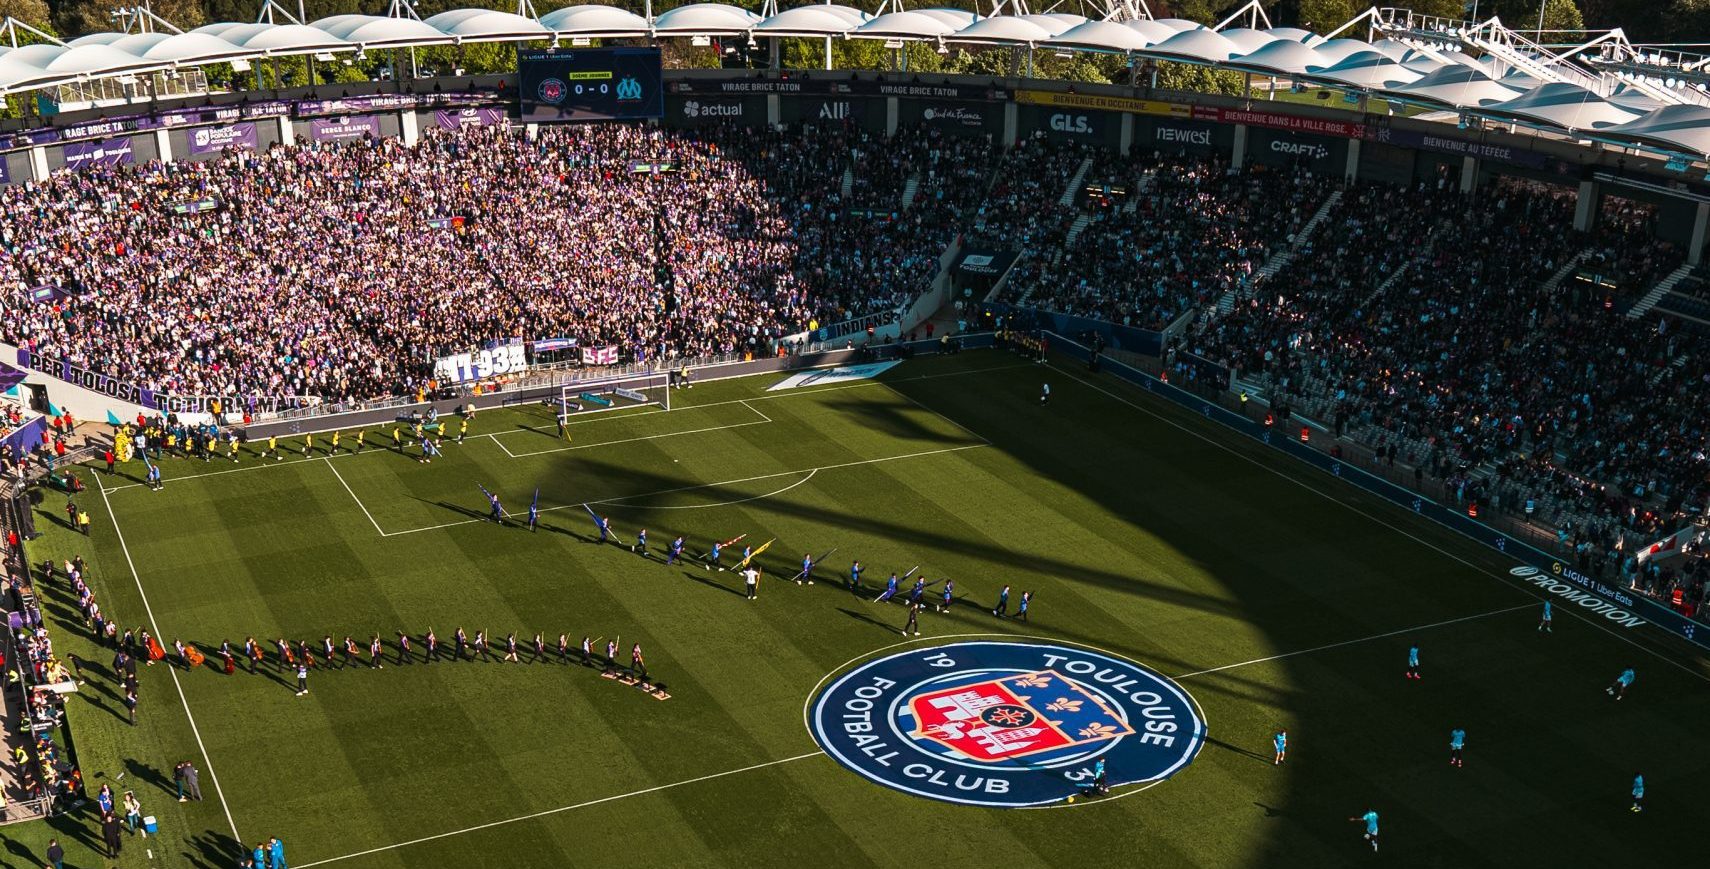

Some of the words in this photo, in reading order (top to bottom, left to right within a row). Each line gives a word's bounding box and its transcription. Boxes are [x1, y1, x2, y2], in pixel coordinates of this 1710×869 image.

[575, 84, 583, 94] 0
[600, 83, 608, 94] 0
[721, 83, 750, 91] VIRAGE
[751, 83, 774, 91] BRICE
[775, 83, 800, 92] TATON
[880, 85, 908, 94] VIRAGE
[909, 86, 932, 95] BRICE
[933, 87, 958, 97] TATON
[701, 103, 742, 116] actual
[1053, 94, 1095, 106] BIENVENUE
[1107, 99, 1147, 110] OCCITANIE
[87, 122, 112, 138] BRICE
[112, 119, 138, 135] TATON
[344, 124, 371, 132] BLANCO
[1050, 113, 1093, 134] GLS.
[1224, 112, 1267, 124] BIENVENUE
[1268, 116, 1289, 126] DANS
[1290, 118, 1300, 128] LA
[1302, 119, 1324, 130] VILLE
[1270, 140, 1316, 156] CRAFT
[1423, 136, 1467, 152] BIENVENUE
[1467, 143, 1479, 154] AU
[29, 352, 64, 379] PER
[70, 366, 143, 405] TOLOSA
[1563, 567, 1590, 585] LIGUE
[1590, 579, 1596, 589] 1
[1596, 583, 1615, 598] Uber
[1615, 591, 1634, 607] Eats
[1526, 574, 1647, 628] PROMOTION
[923, 652, 956, 669] 19
[1042, 653, 1178, 748] TOULOUSE
[843, 676, 896, 767] FOOTBALL
[903, 763, 1010, 795] CLUB
